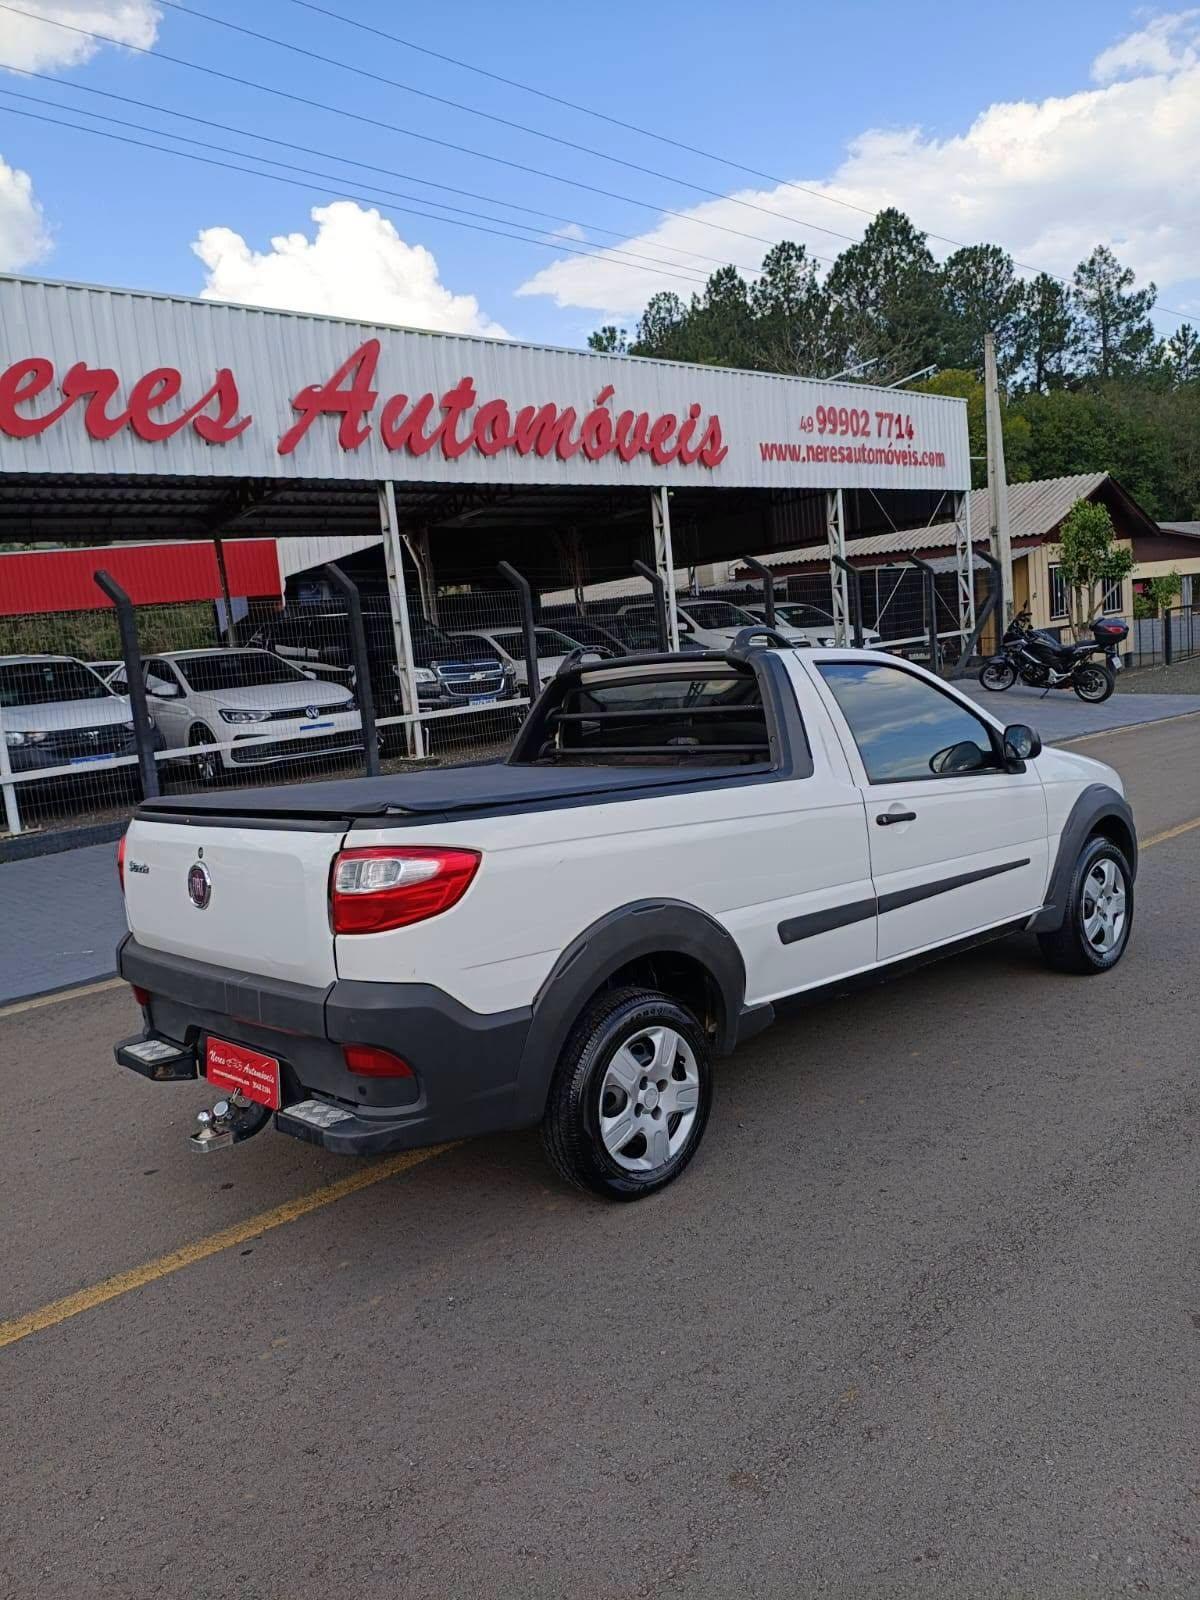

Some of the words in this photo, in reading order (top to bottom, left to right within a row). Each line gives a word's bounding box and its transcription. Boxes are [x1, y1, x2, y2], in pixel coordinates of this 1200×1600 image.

[277, 338, 728, 467] Automóveis
[800, 416, 814, 433] 49
[815, 404, 871, 437] 99902
[875, 411, 914, 440] 7714
[759, 442, 946, 467] www.neresautomóveis.com
